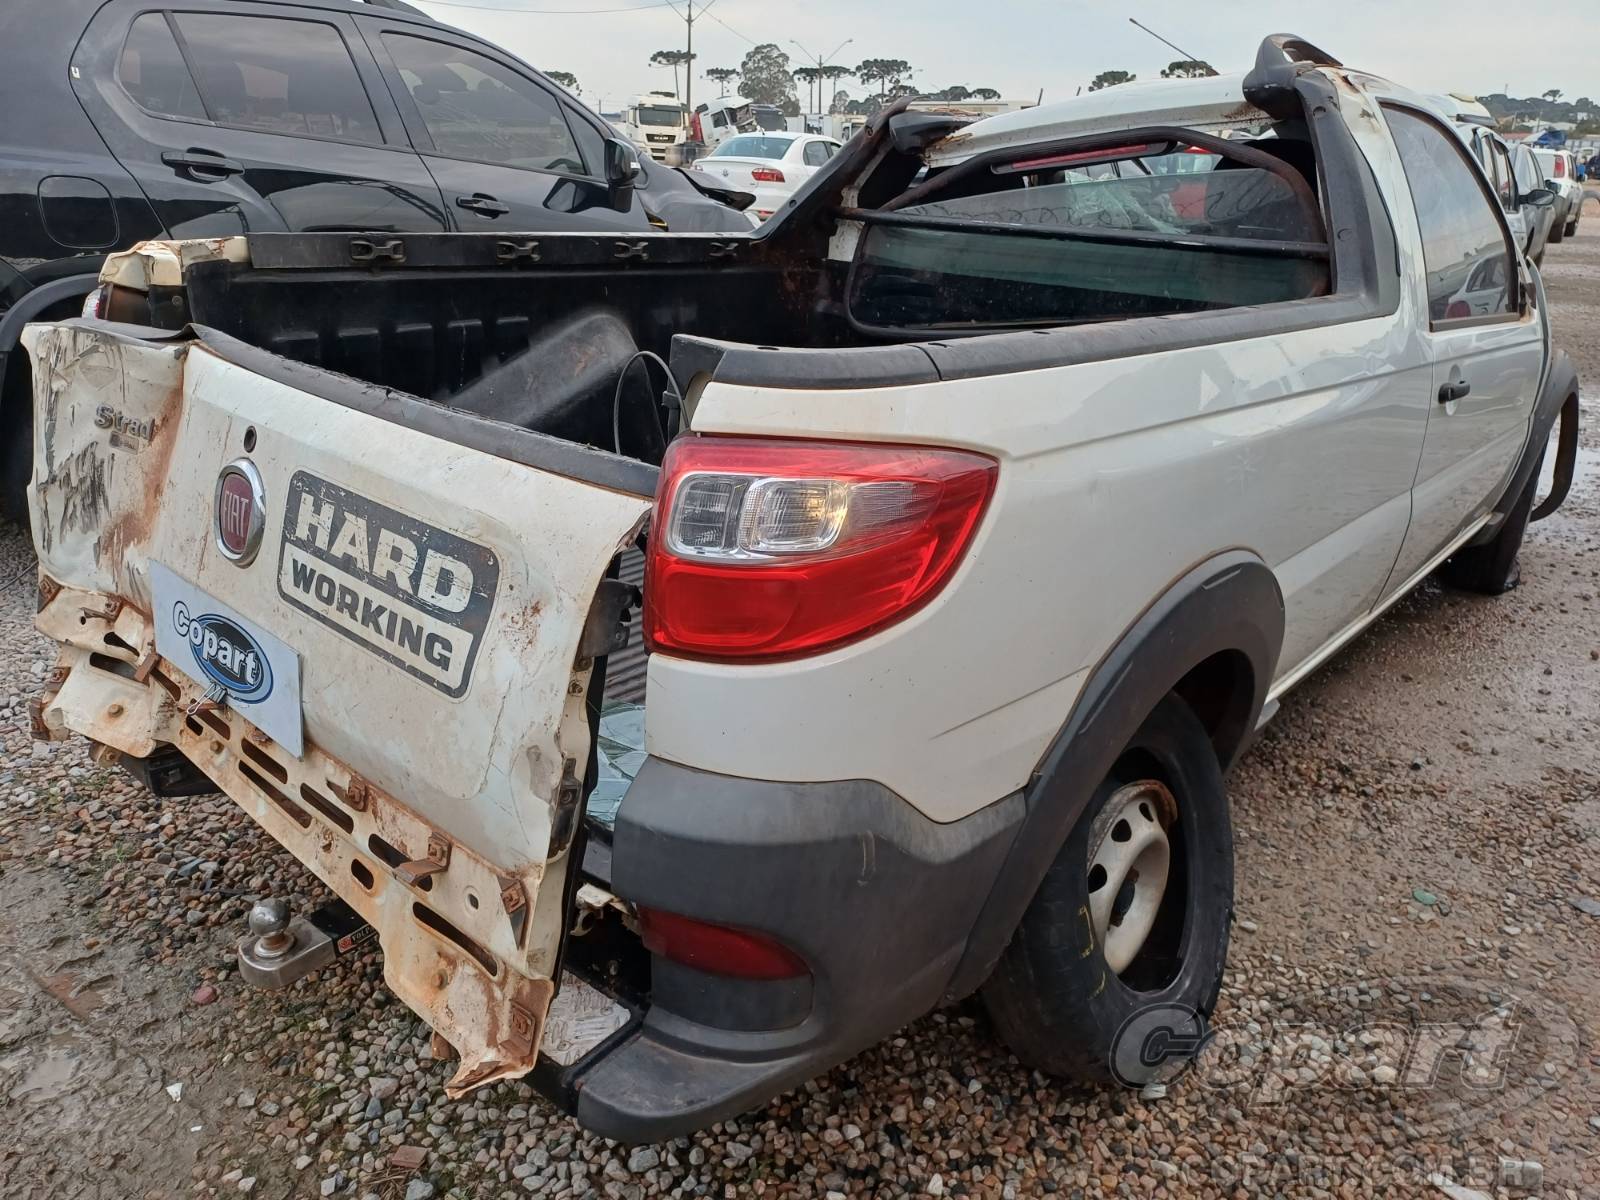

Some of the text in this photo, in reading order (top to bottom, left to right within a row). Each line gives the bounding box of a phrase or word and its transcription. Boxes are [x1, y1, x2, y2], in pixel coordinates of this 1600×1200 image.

[223, 490, 249, 538] FIAT
[295, 492, 474, 613] HARD
[172, 600, 261, 687] Copart
[292, 558, 453, 672] WORKING
